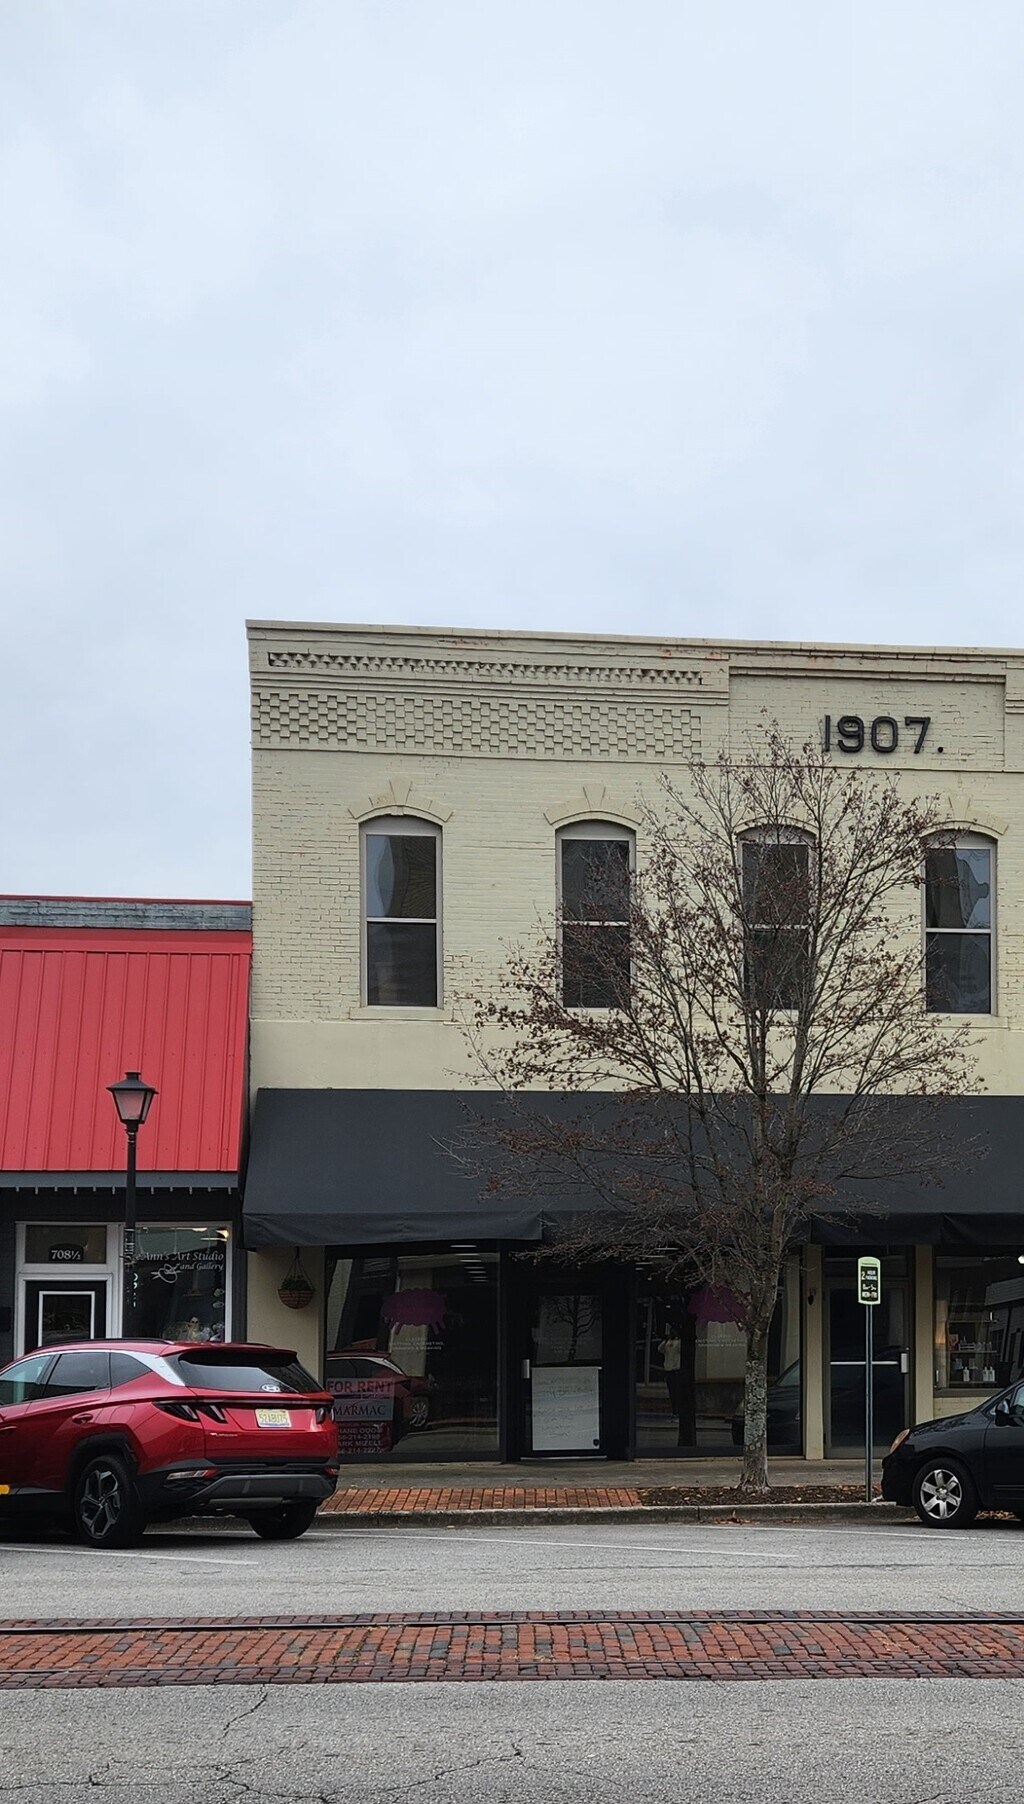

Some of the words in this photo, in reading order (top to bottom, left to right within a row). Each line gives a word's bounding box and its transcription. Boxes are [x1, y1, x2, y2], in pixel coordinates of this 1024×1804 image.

[173, 1252, 190, 1260] Art
[193, 1251, 224, 1260] Studio
[197, 1262, 223, 1271] Gallery
[861, 1271, 866, 1280] 2
[327, 1381, 352, 1392] FOR
[357, 1381, 392, 1392] RENT
[335, 1404, 386, 1415] MARMAC
